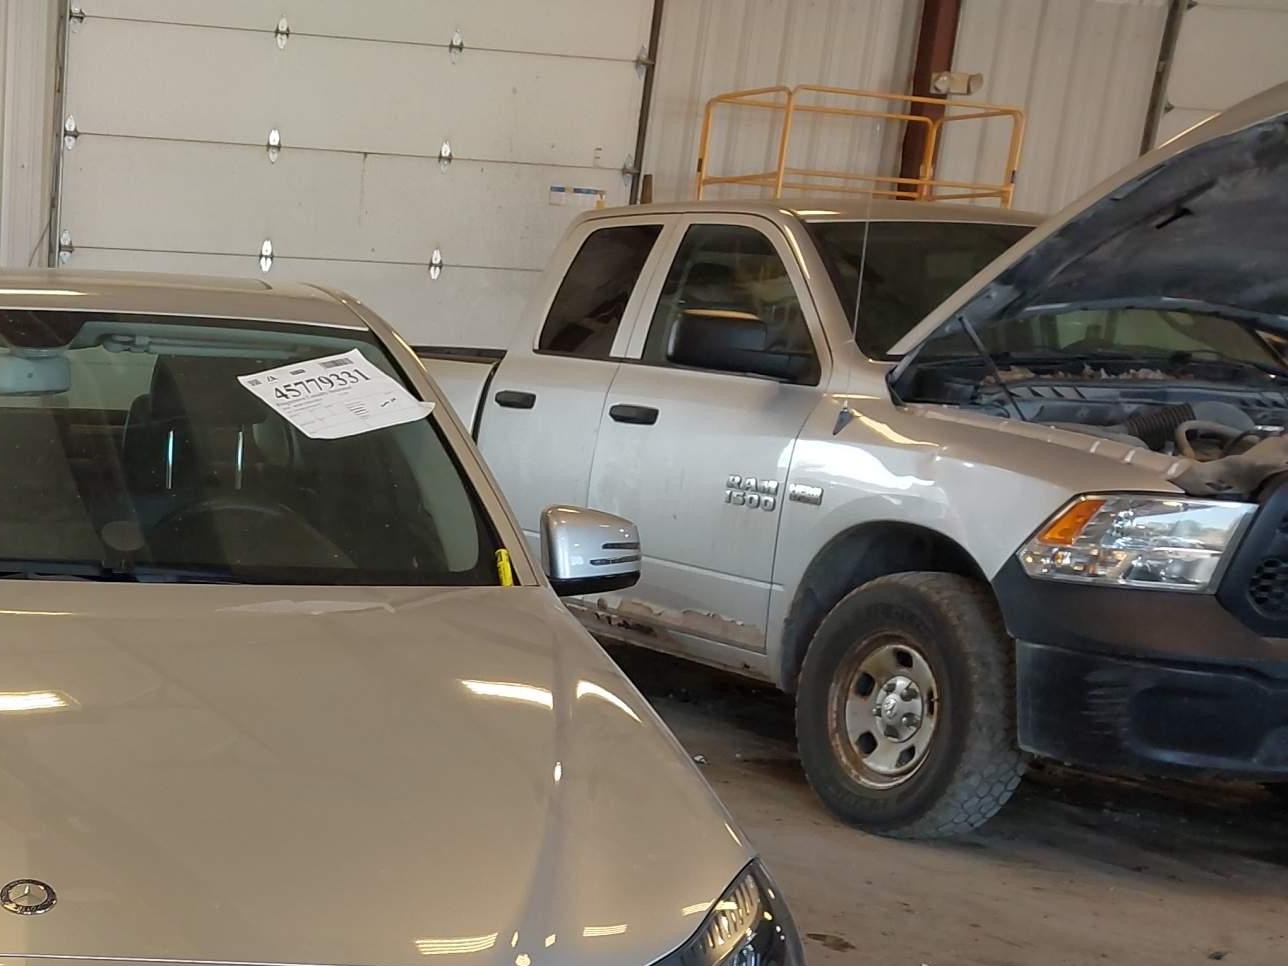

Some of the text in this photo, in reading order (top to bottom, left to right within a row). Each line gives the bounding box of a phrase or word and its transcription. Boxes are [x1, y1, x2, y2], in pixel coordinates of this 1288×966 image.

[273, 368, 371, 400] 45779331
[726, 474, 779, 496] RAM
[723, 490, 777, 512] 1500
